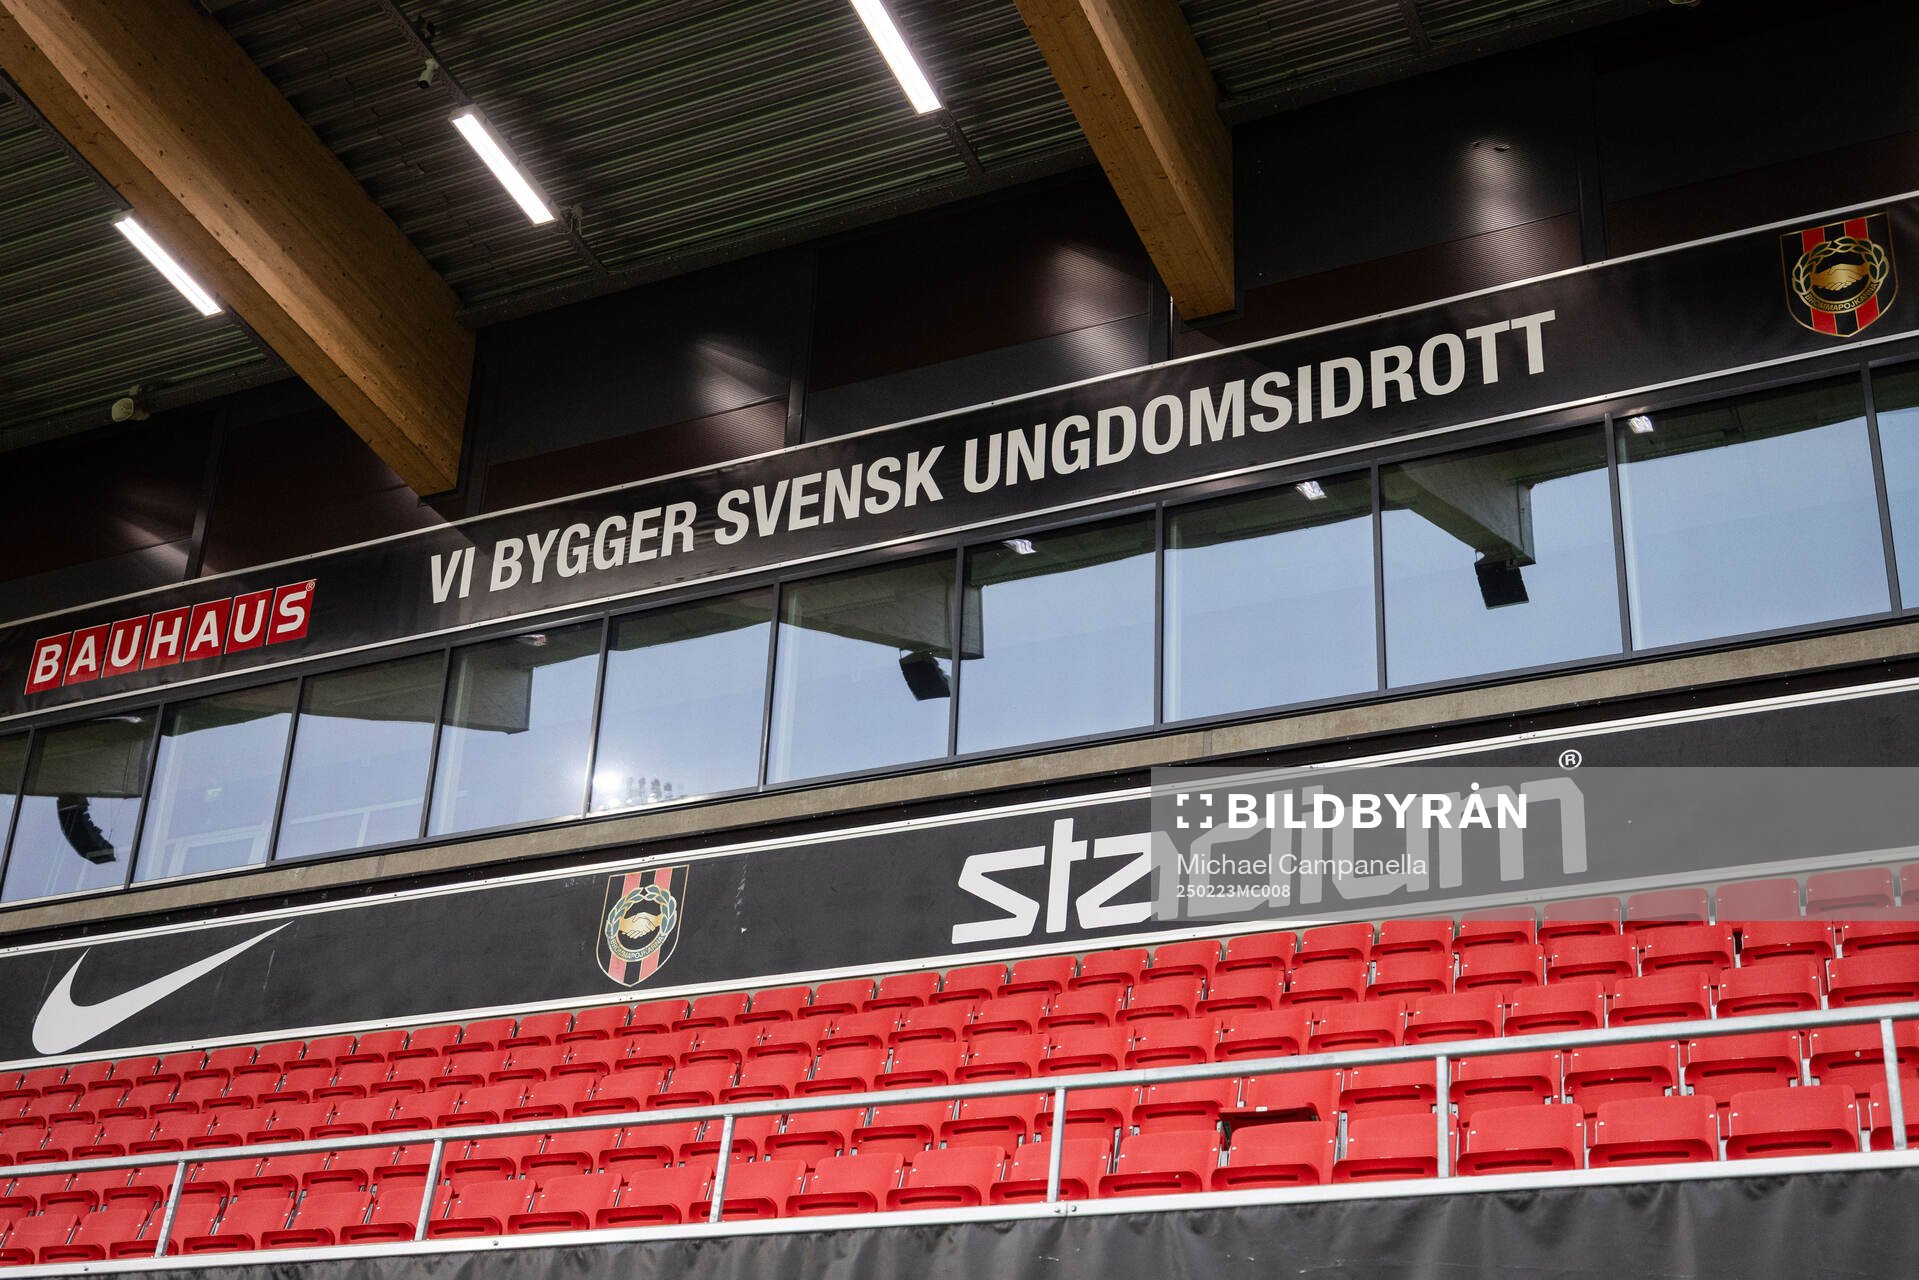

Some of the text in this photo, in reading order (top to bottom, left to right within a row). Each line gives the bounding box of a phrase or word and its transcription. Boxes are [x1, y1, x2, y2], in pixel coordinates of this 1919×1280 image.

[430, 309, 1556, 604] VI BYGGER SVENSK UNGDOMSIDROTT
[32, 589, 309, 685] BAUHAUS
